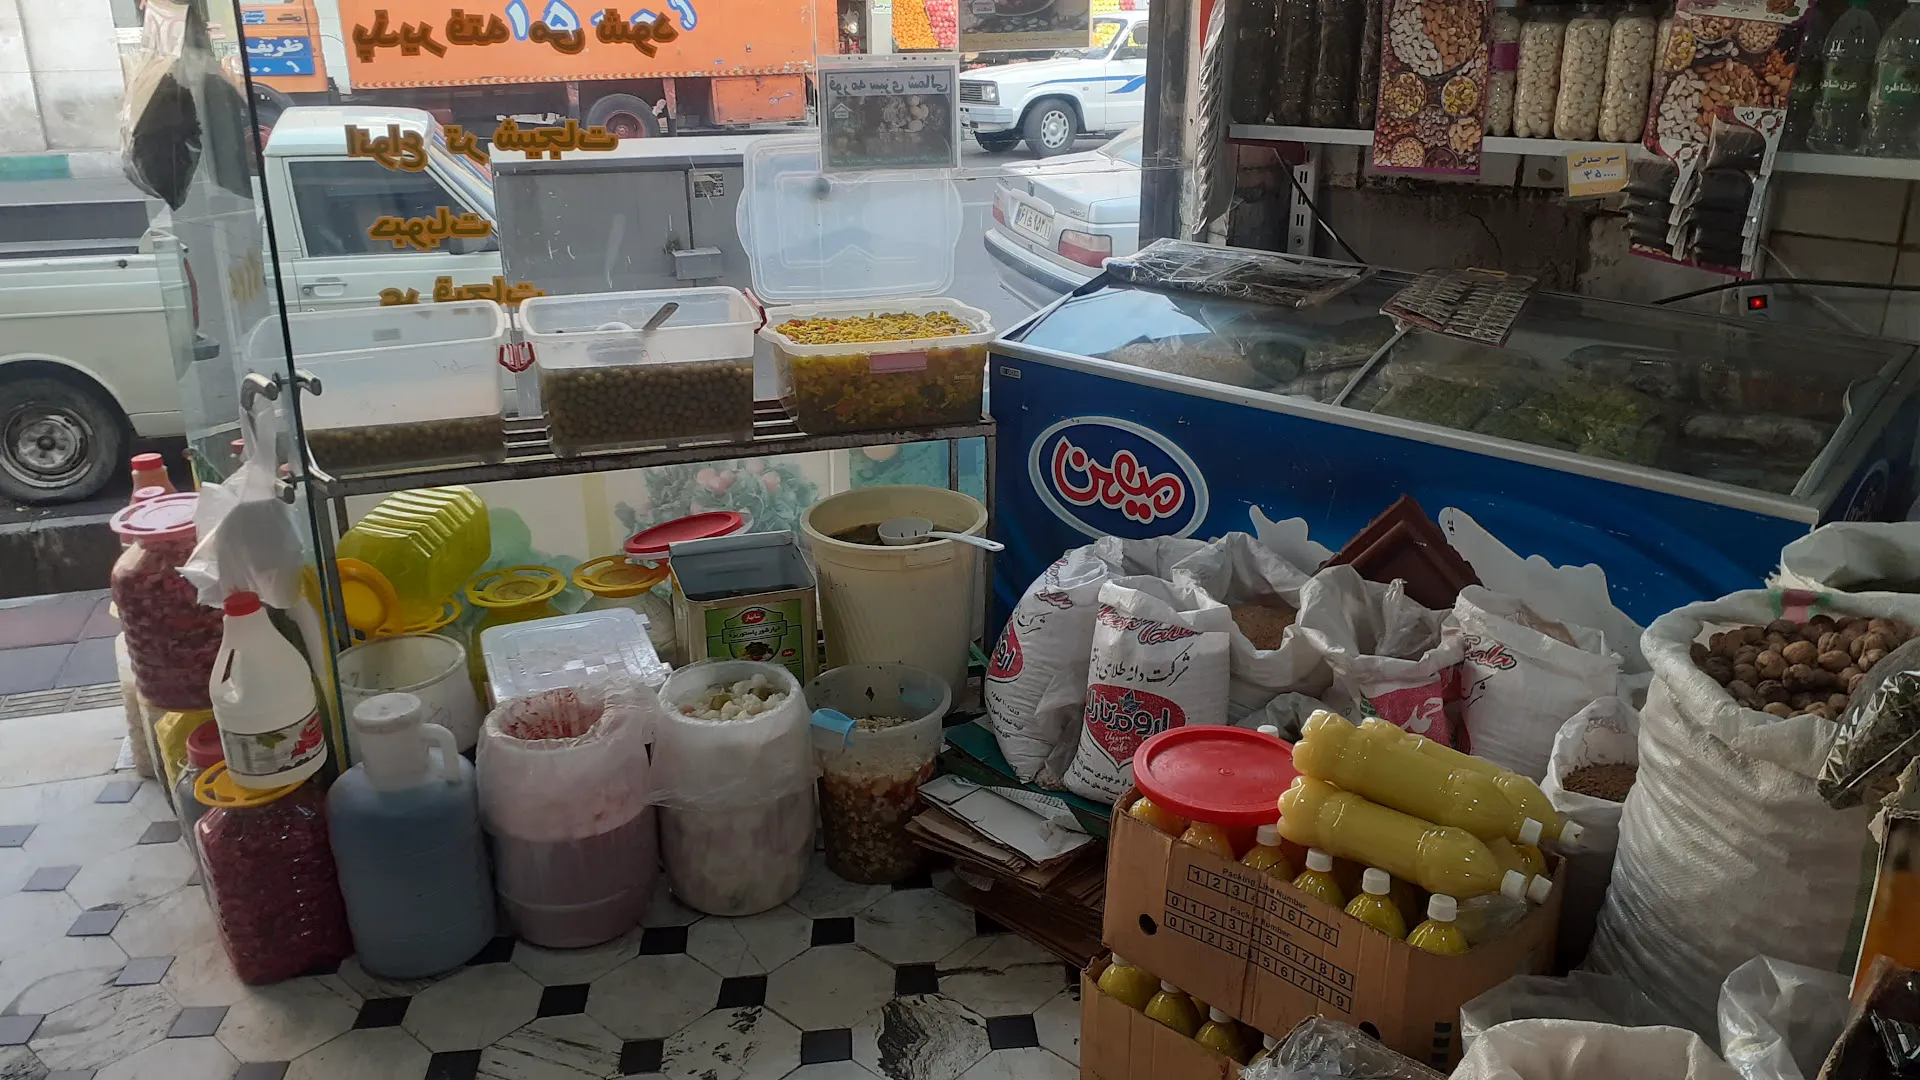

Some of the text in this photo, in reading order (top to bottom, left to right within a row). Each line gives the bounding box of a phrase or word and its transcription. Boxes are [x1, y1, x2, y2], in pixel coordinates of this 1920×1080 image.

[1051, 435, 1185, 524] میهن
[1147, 642, 1194, 687] شرکت
[1193, 870, 1202, 882] 1
[1212, 877, 1221, 889] 2
[1232, 884, 1240, 896] 3
[1270, 900, 1277, 912] 5
[1288, 909, 1296, 922] 6
[1307, 918, 1314, 930] 7
[1324, 928, 1332, 940] 8
[1222, 868, 1256, 887] Packing
[1276, 889, 1309, 910] Number:
[1169, 917, 1177, 927] 0
[1189, 925, 1195, 936] 1
[1207, 932, 1215, 943] 2
[1226, 939, 1234, 951] 3
[1263, 956, 1270, 968] 5
[1280, 966, 1288, 977] 6
[1299, 975, 1306, 987] 7
[1317, 984, 1325, 996] 8
[1337, 995, 1344, 1006] 9
[1171, 896, 1179, 907] 0
[1191, 903, 1197, 915] 1
[1209, 911, 1217, 922] 2
[1228, 918, 1236, 930] 3
[1265, 934, 1273, 946] 5
[1283, 944, 1291, 955] 6
[1301, 953, 1309, 964] 7
[1319, 962, 1327, 975] 8
[1338, 973, 1346, 984] 9
